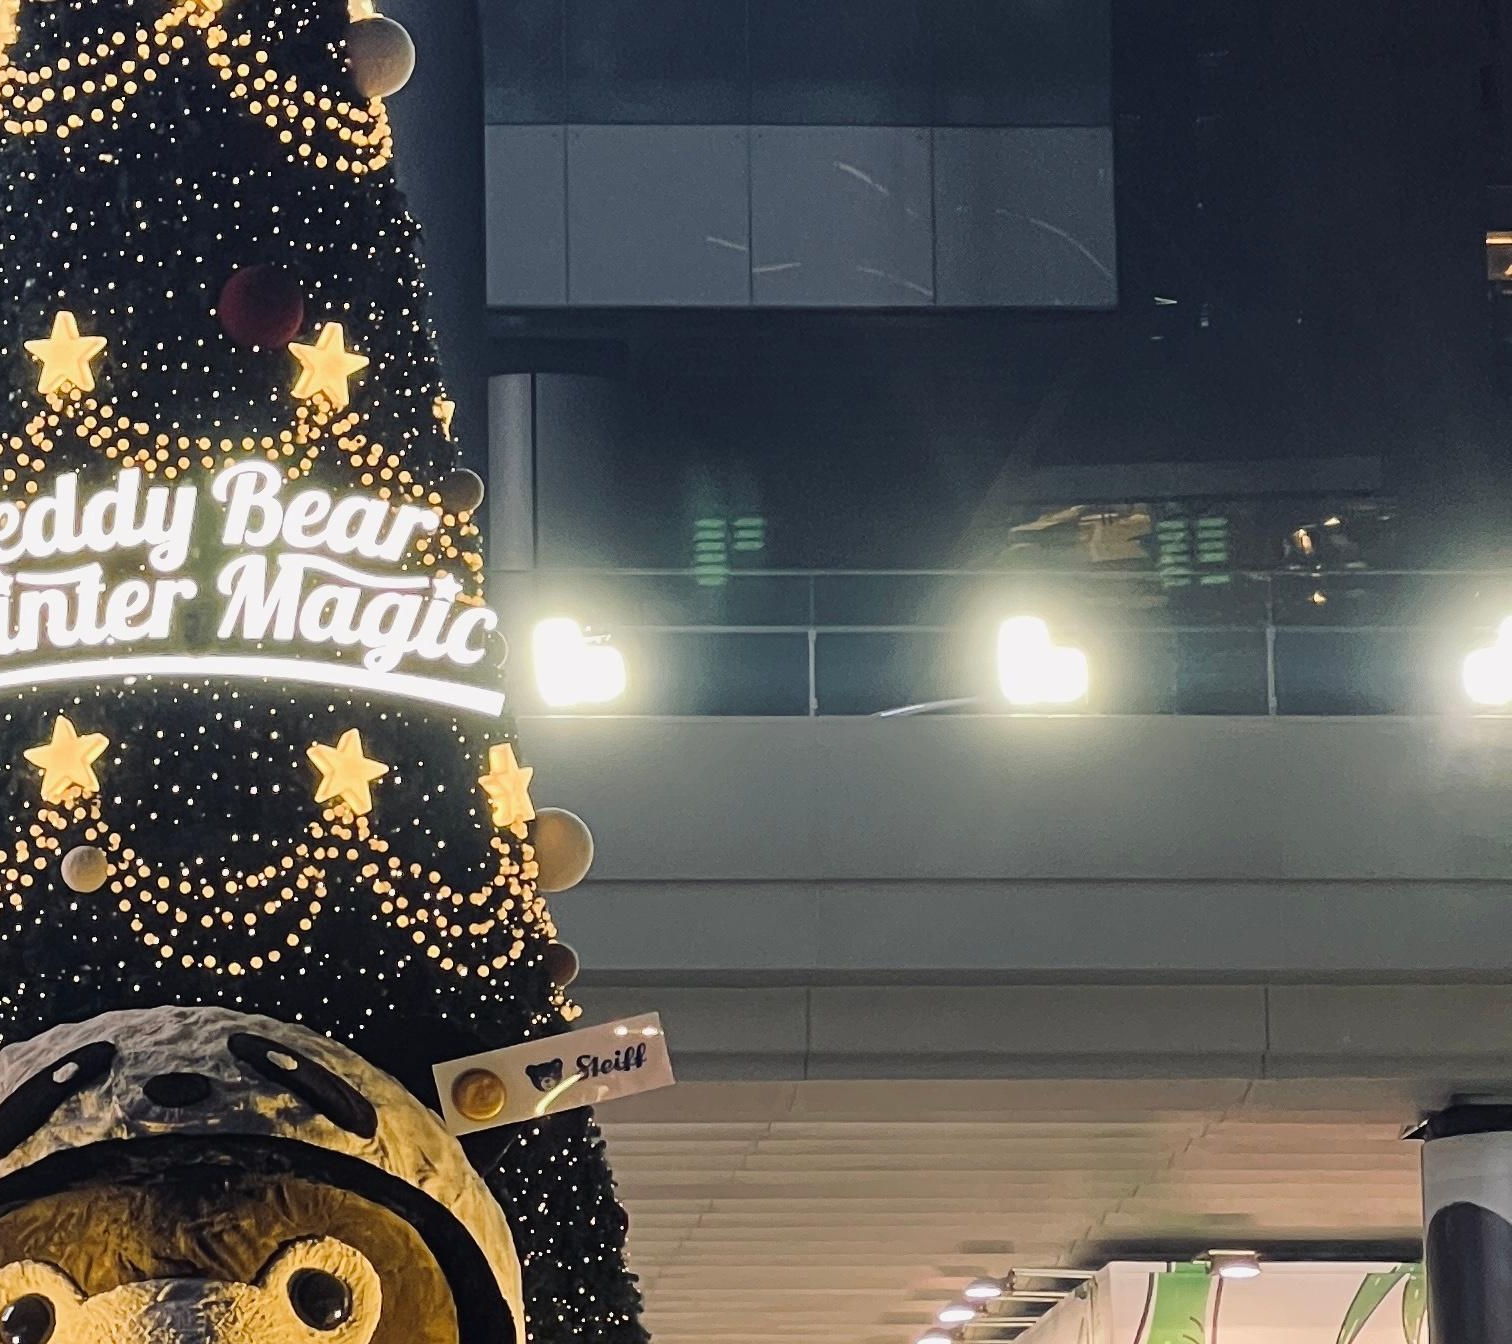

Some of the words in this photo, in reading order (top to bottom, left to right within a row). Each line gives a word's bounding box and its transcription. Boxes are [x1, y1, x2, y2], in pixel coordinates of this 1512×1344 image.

[212, 460, 440, 560] Bear
[217, 554, 498, 672] Magic
[575, 1042, 647, 1080] Steiff
